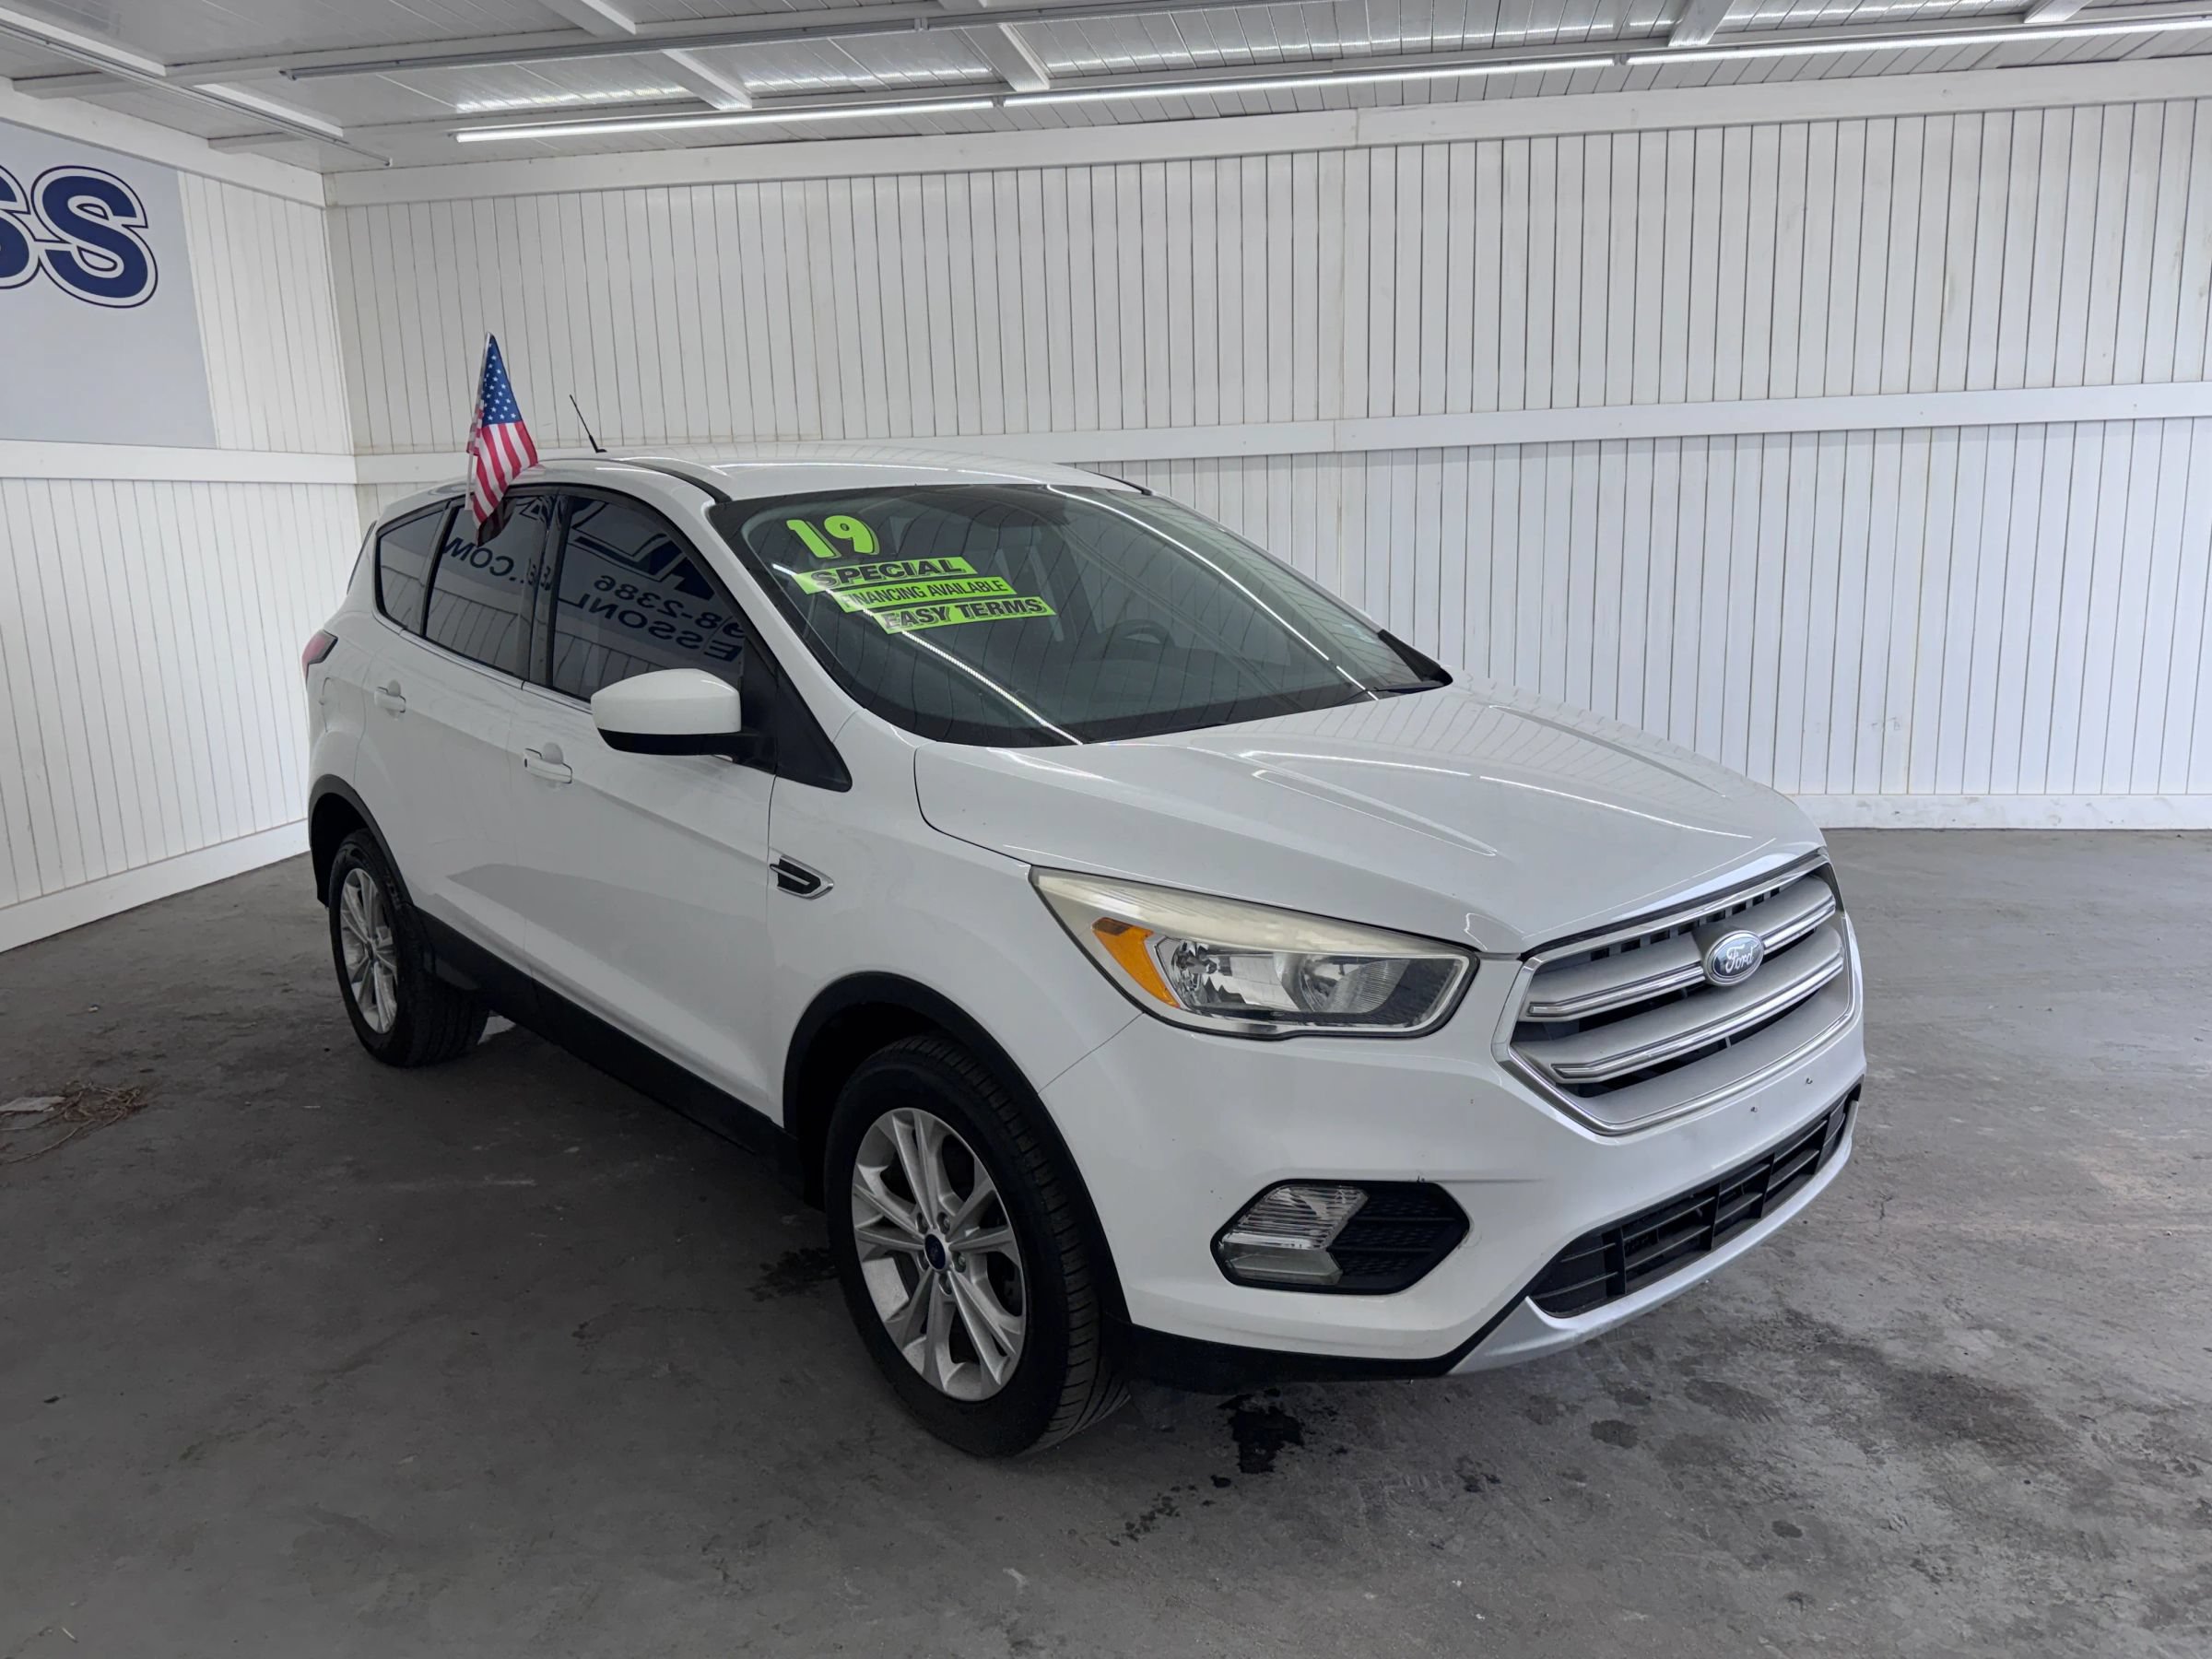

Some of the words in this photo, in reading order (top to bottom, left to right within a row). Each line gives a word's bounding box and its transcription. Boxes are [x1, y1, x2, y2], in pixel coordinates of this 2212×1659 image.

[786, 515, 880, 559] 19
[810, 559, 967, 588] SPECIAL
[929, 580, 1009, 597] AVAILABLE
[879, 606, 952, 630] EASY
[954, 598, 1048, 620] TERMS
[1725, 943, 1759, 974] Ford
